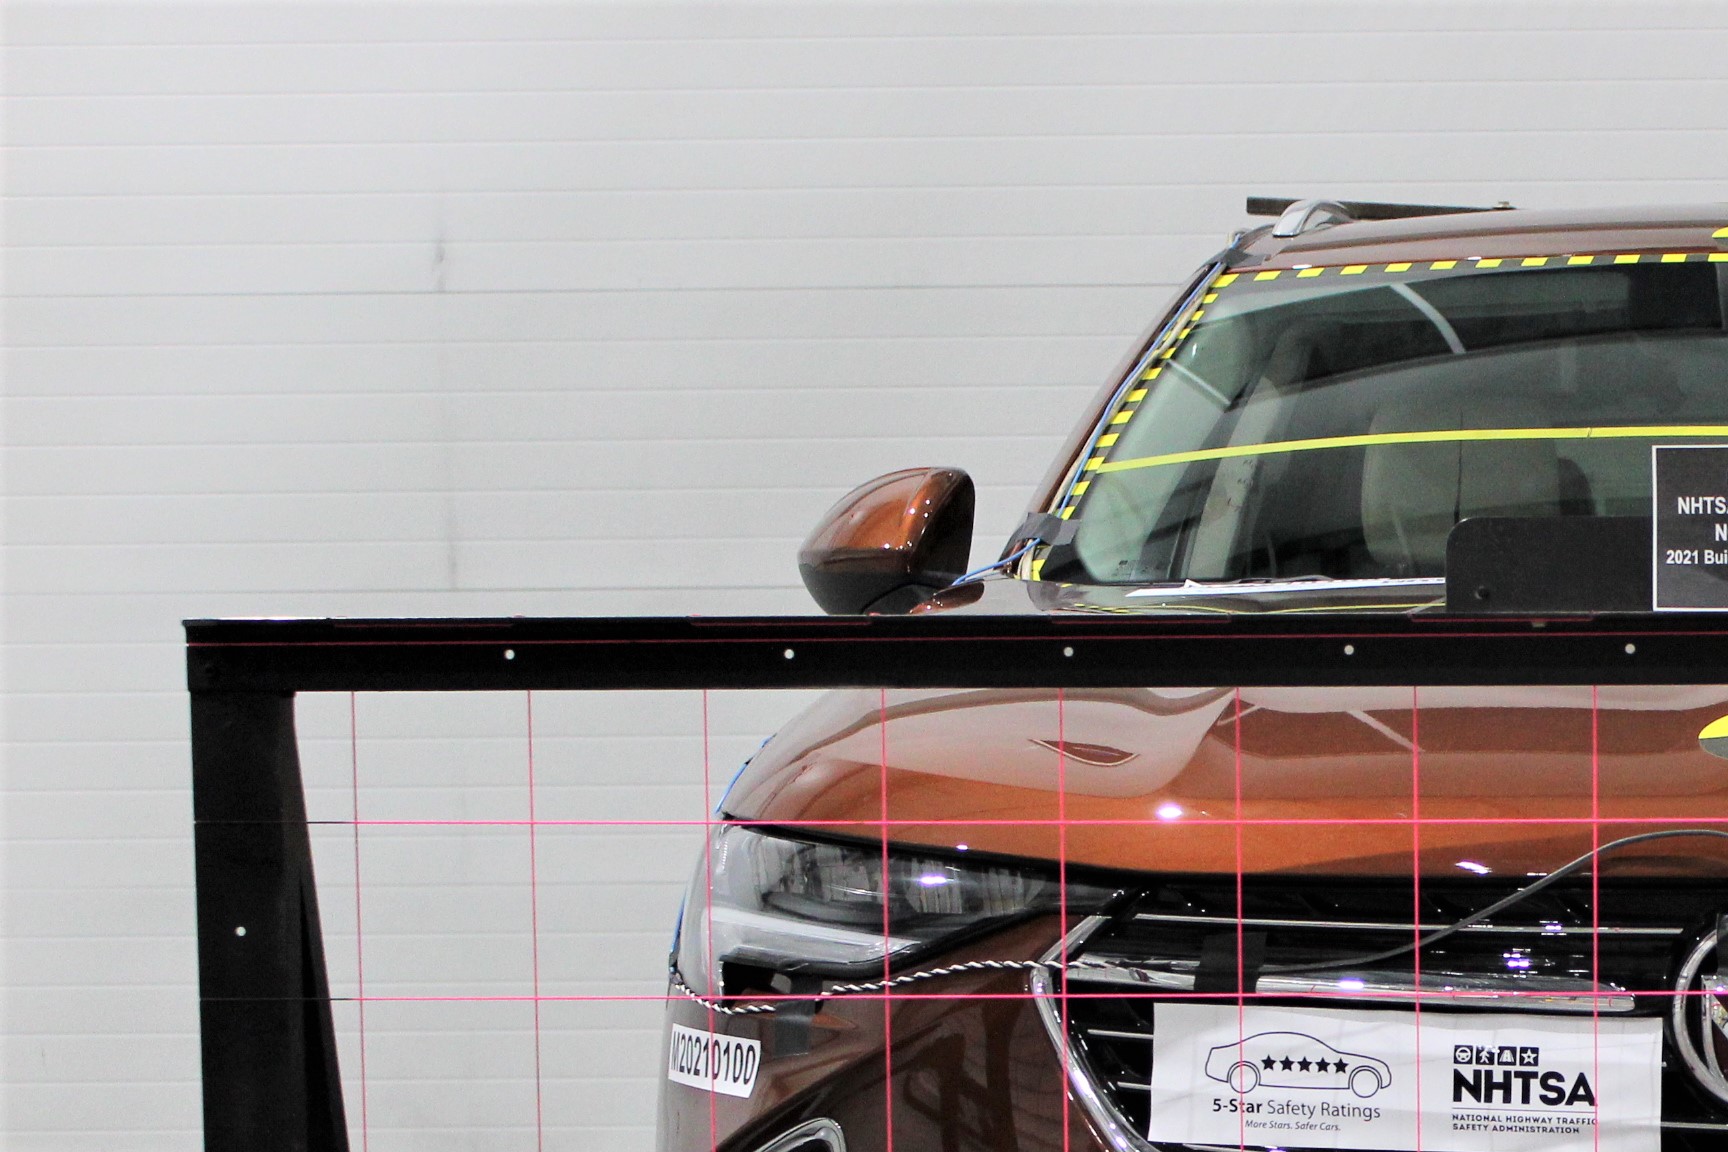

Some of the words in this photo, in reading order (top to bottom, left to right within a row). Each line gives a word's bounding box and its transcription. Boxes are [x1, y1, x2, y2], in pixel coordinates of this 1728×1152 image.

[1666, 550, 1699, 565] 2021
[670, 1031, 756, 1085] M20210100
[1452, 1068, 1598, 1107] NHTSA
[1212, 1098, 1263, 1114] 5-Star
[1267, 1100, 1316, 1120] Safety
[1321, 1101, 1381, 1122] Ratings
[1245, 1120, 1267, 1129] More
[1268, 1120, 1293, 1130] Stars.
[1295, 1121, 1317, 1131] Safer
[1319, 1122, 1341, 1132] Cars.
[1452, 1114, 1502, 1123] NATIONAL
[1506, 1115, 1553, 1124] HIGHWAY
[1556, 1117, 1598, 1125] TRAFFIC
[1453, 1124, 1489, 1132] SAFETY
[1491, 1125, 1580, 1134] ADMINISTRATION
